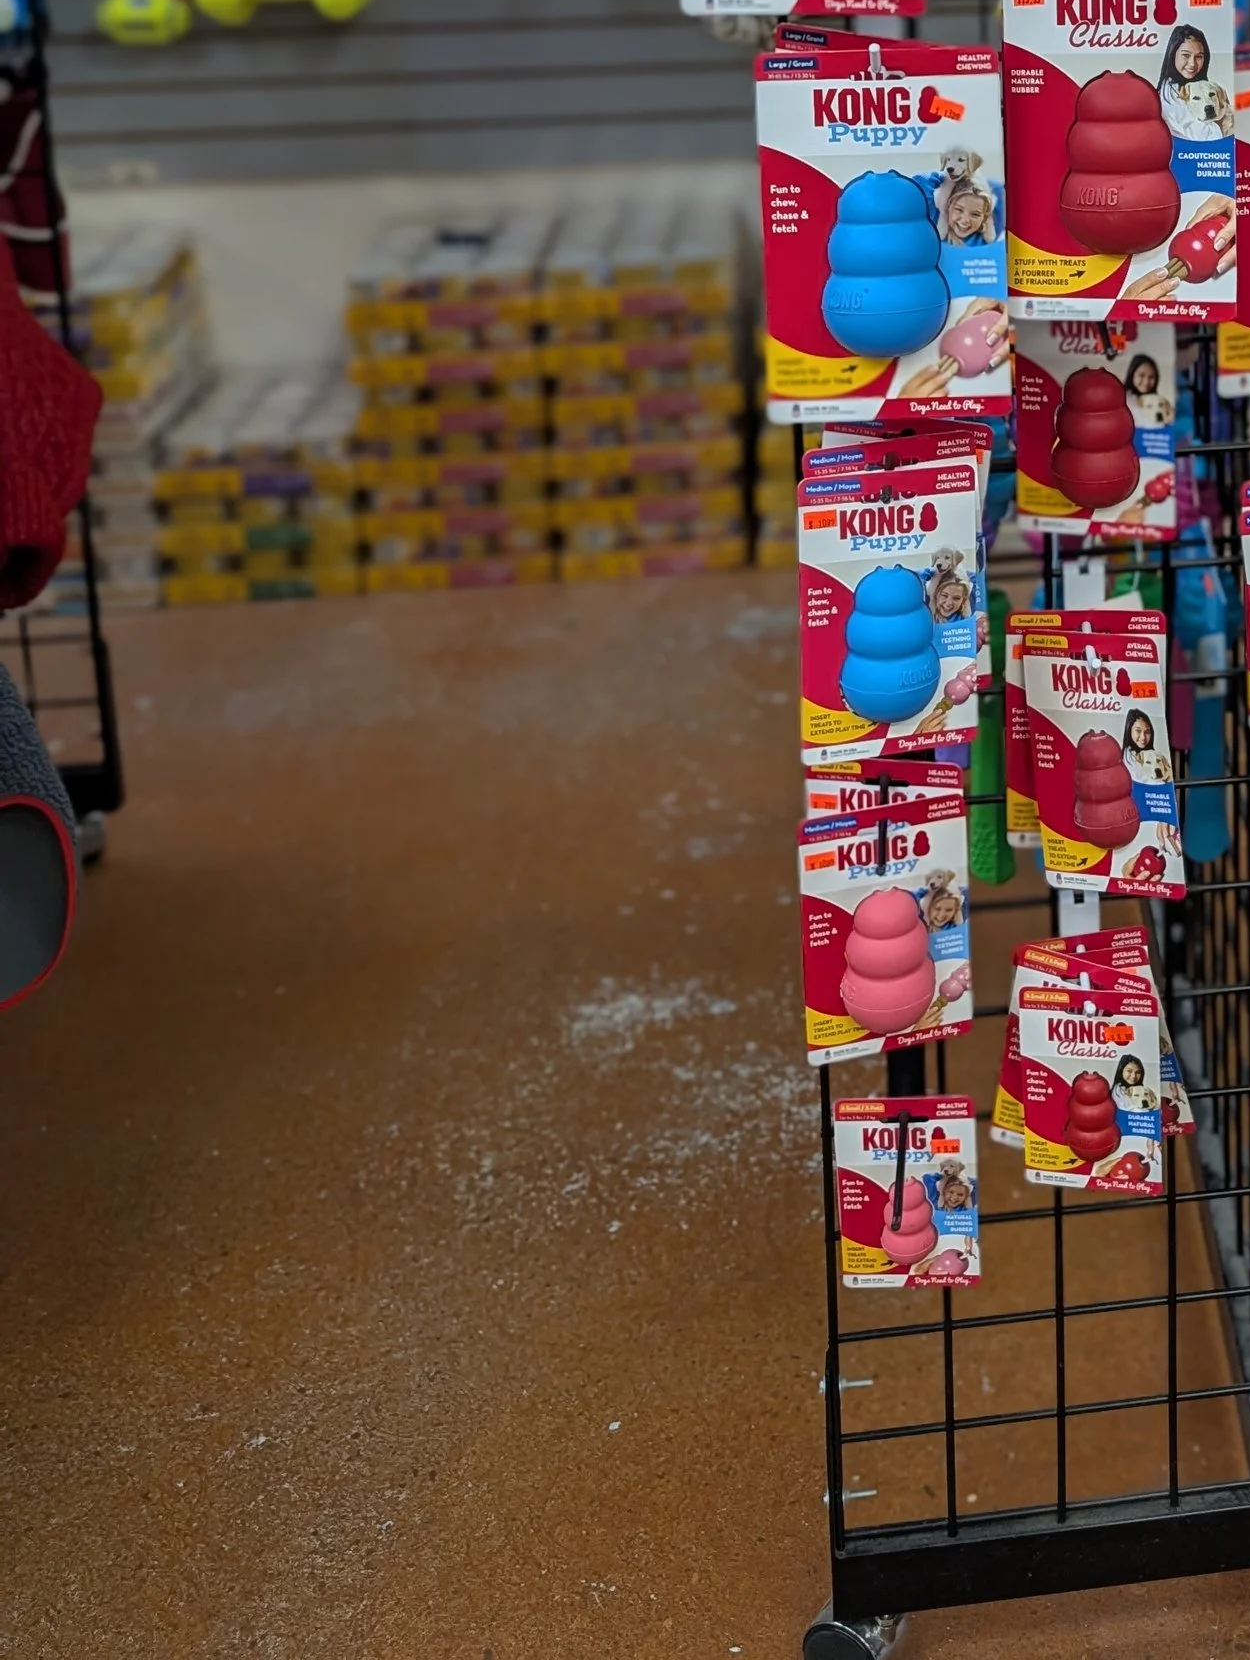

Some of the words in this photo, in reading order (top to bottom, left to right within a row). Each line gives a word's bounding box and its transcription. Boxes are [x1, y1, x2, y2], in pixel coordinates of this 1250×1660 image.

[1069, 19, 1159, 48] Classic
[957, 54, 991, 62] HEALTHY
[956, 62, 992, 72] CHEWING
[813, 87, 912, 127] KONG
[828, 122, 927, 147] Puppy
[1178, 153, 1230, 161] CAOUTCHOUC
[1197, 161, 1230, 169] NATUREL
[1196, 170, 1230, 178] DURABLE
[1077, 187, 1119, 206] KONG
[1015, 259, 1037, 267] STUFF
[1039, 259, 1058, 267] WITH
[1060, 259, 1086, 267] TREATS
[1015, 267, 1020, 278] À
[1022, 269, 1055, 278] FOURRER
[1015, 277, 1024, 285] DE
[1026, 277, 1069, 286] FRIANDISES
[937, 472, 970, 481] HEALTHY
[936, 480, 970, 490] CHEWING
[839, 504, 916, 540] KONG
[850, 534, 926, 552] Puppy
[1052, 663, 1112, 695] KONG
[1062, 688, 1122, 712] Classic
[1122, 998, 1152, 1006] AVERAGE
[1120, 1005, 1152, 1013] CHEWERS
[1057, 1039, 1118, 1059] Classic
